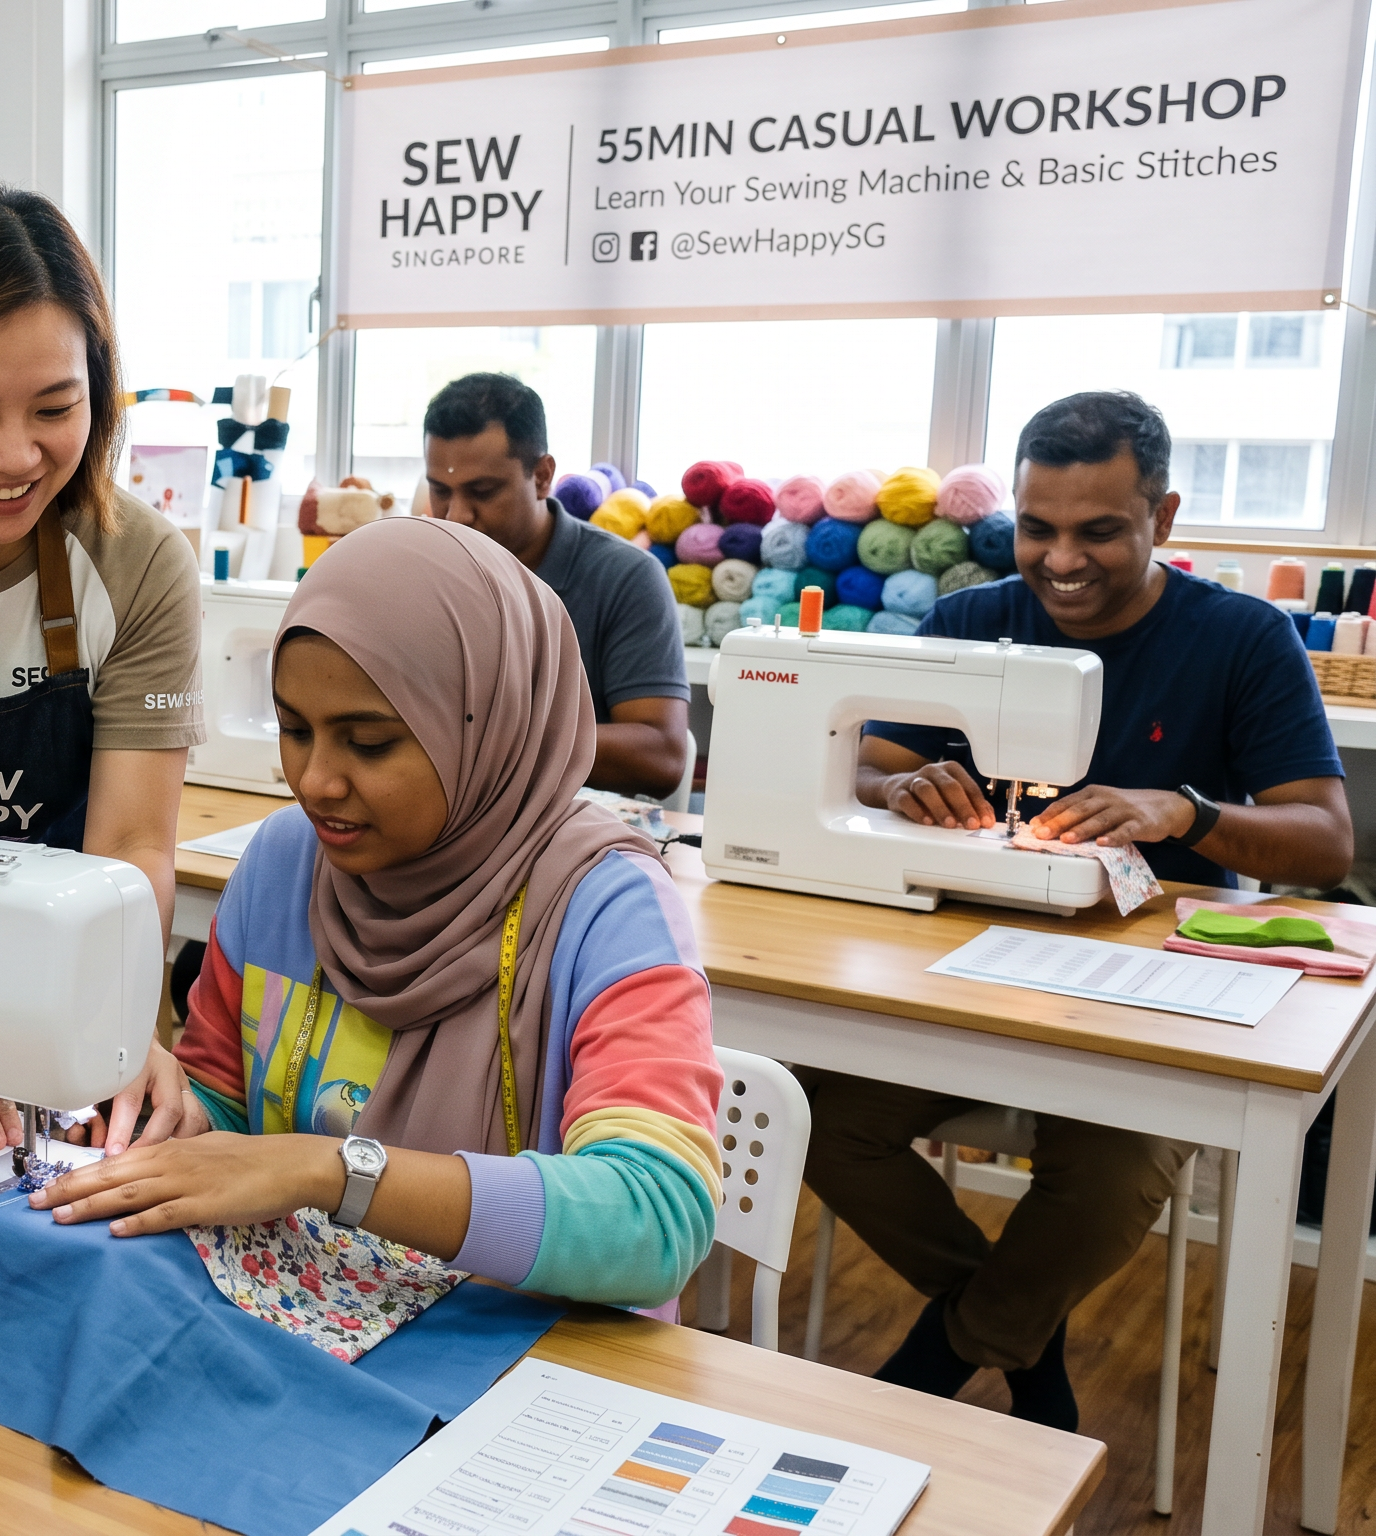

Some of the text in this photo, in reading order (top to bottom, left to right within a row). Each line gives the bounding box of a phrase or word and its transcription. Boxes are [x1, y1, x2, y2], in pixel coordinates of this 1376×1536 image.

[595, 74, 1287, 165] 55MIN CASUAL WORKSHOP
[402, 134, 522, 187] SEW
[595, 145, 1279, 211] Learn Your Sewing Machine & Basic Stitches
[380, 189, 543, 239] HAPPY
[391, 245, 526, 268] SINGAPORE
[670, 222, 887, 261] @SewHappySG
[738, 669, 799, 684] JANOME
